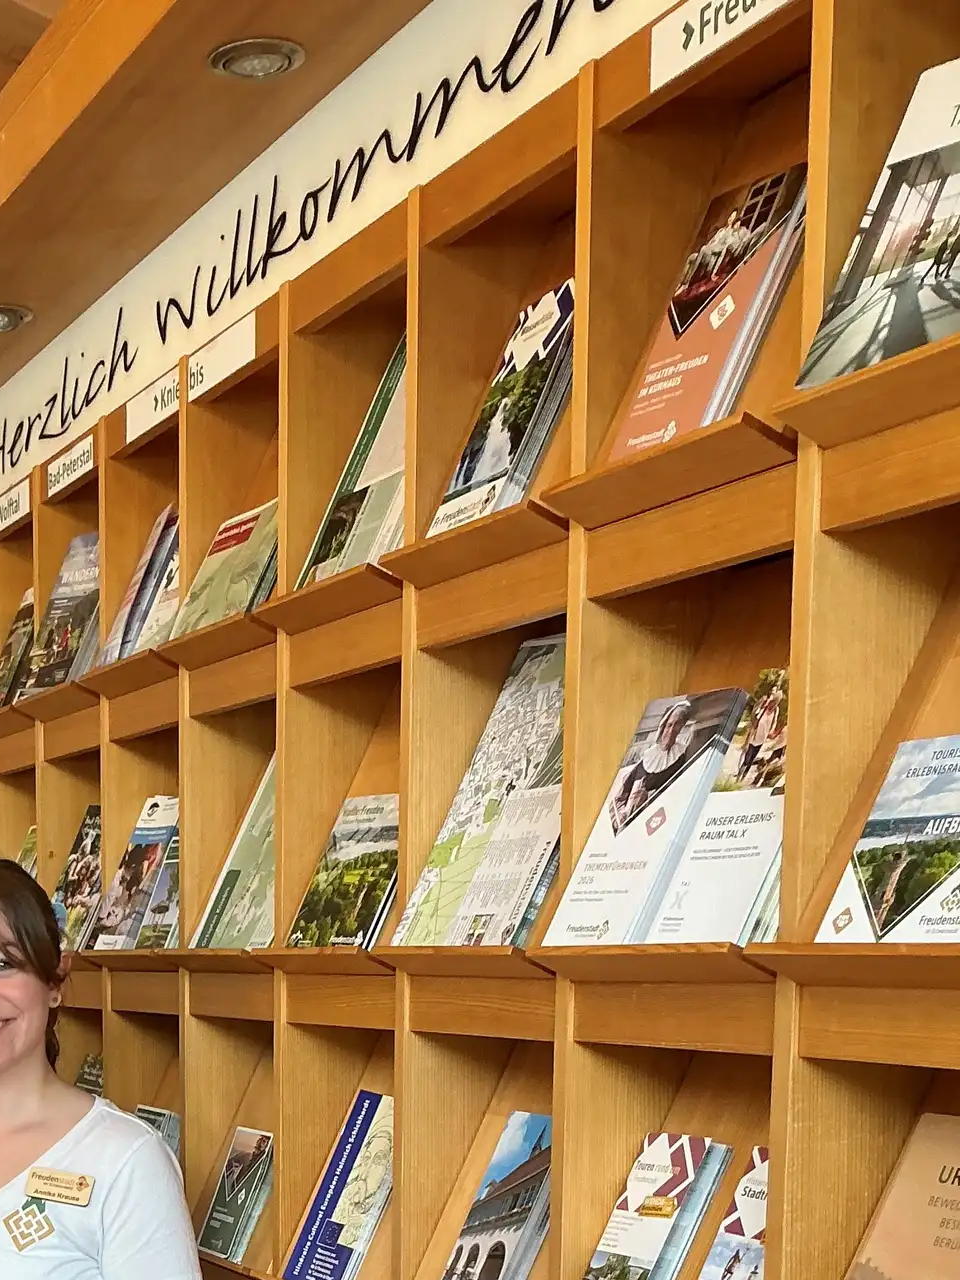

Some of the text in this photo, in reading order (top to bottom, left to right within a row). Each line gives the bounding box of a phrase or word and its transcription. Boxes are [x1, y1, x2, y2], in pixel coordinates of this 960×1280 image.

[644, 354, 709, 384] THEATER-FREUDEN
[649, 376, 682, 396] KURHAUS
[48, 443, 92, 490] Bad-Peterstal
[705, 812, 776, 827] UNSER ERLEBNIS-
[923, 816, 960, 836] AUFB
[699, 829, 748, 840] RAUM TAL X
[584, 861, 648, 872] THEMENFÜHRUNGEN
[635, 1160, 655, 1172] Touren
[31, 1172, 75, 1186] Freudenstadt
[293, 1239, 311, 1275] Itinéraire
[308, 1211, 324, 1241] Culturel
[320, 1175, 338, 1211] Européen
[335, 1143, 352, 1175] Heinrich
[348, 1099, 371, 1143] Schickhardt
[57, 1193, 80, 1202] Krause
